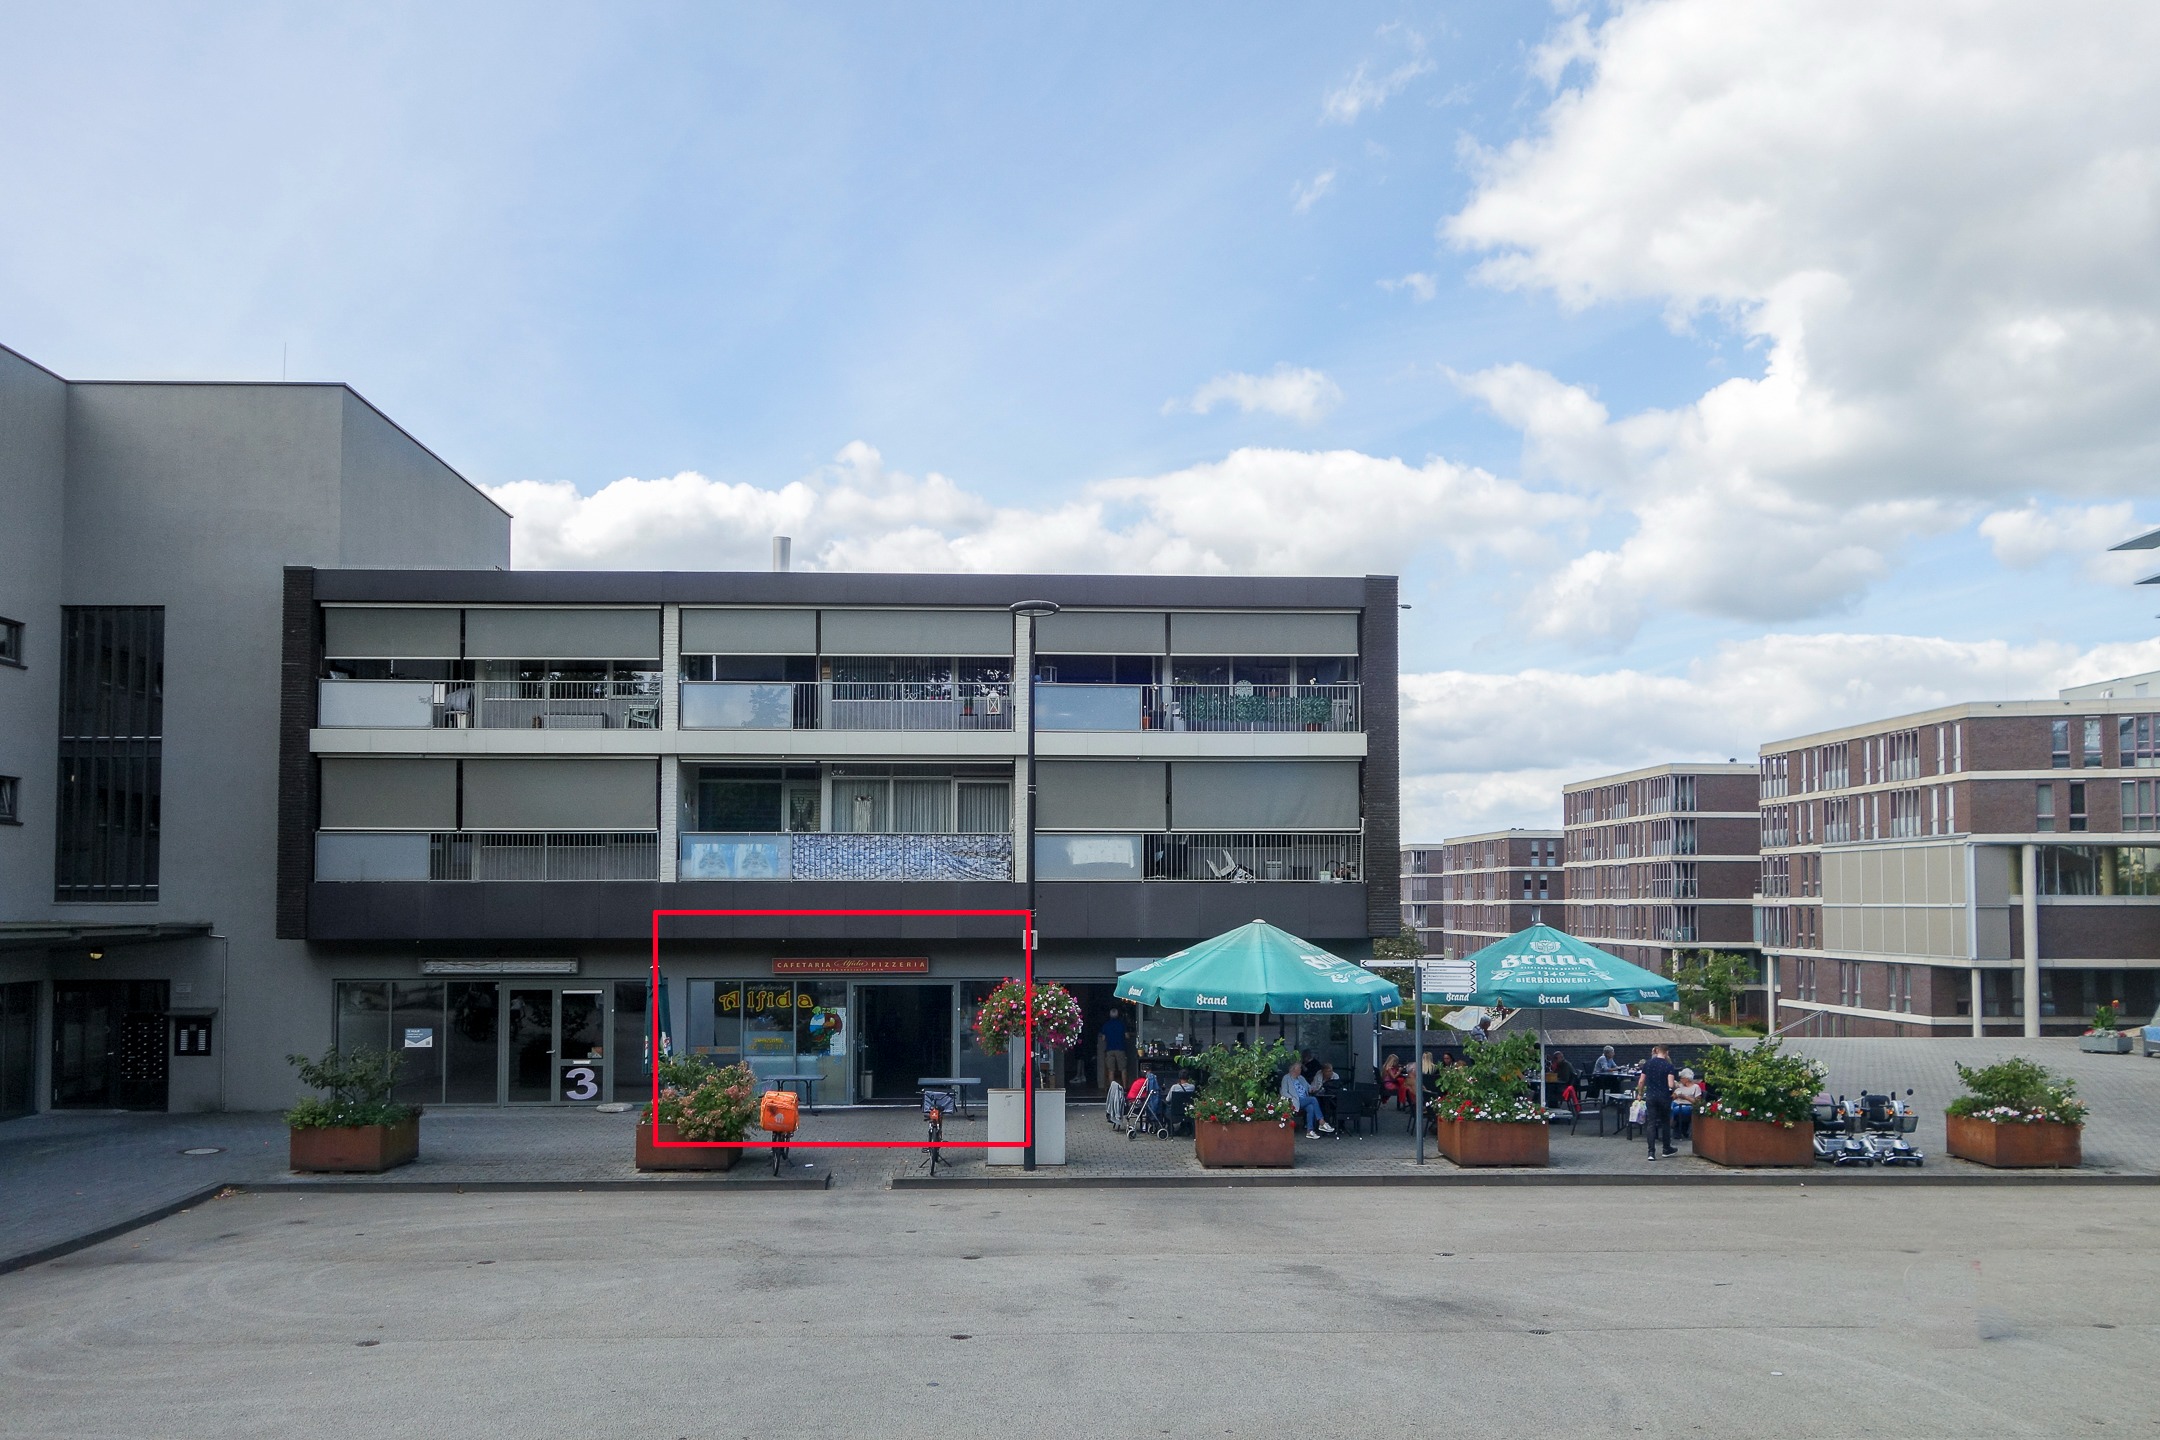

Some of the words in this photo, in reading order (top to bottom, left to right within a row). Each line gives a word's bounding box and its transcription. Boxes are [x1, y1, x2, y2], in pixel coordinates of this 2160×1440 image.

[718, 990, 814, 1012] Alfida
[1196, 994, 1228, 1006] Brand
[1445, 992, 1470, 1002] Brand
[1538, 994, 1571, 1005] Brand
[1303, 998, 1334, 1010] Brand
[565, 1067, 598, 1100] 3
